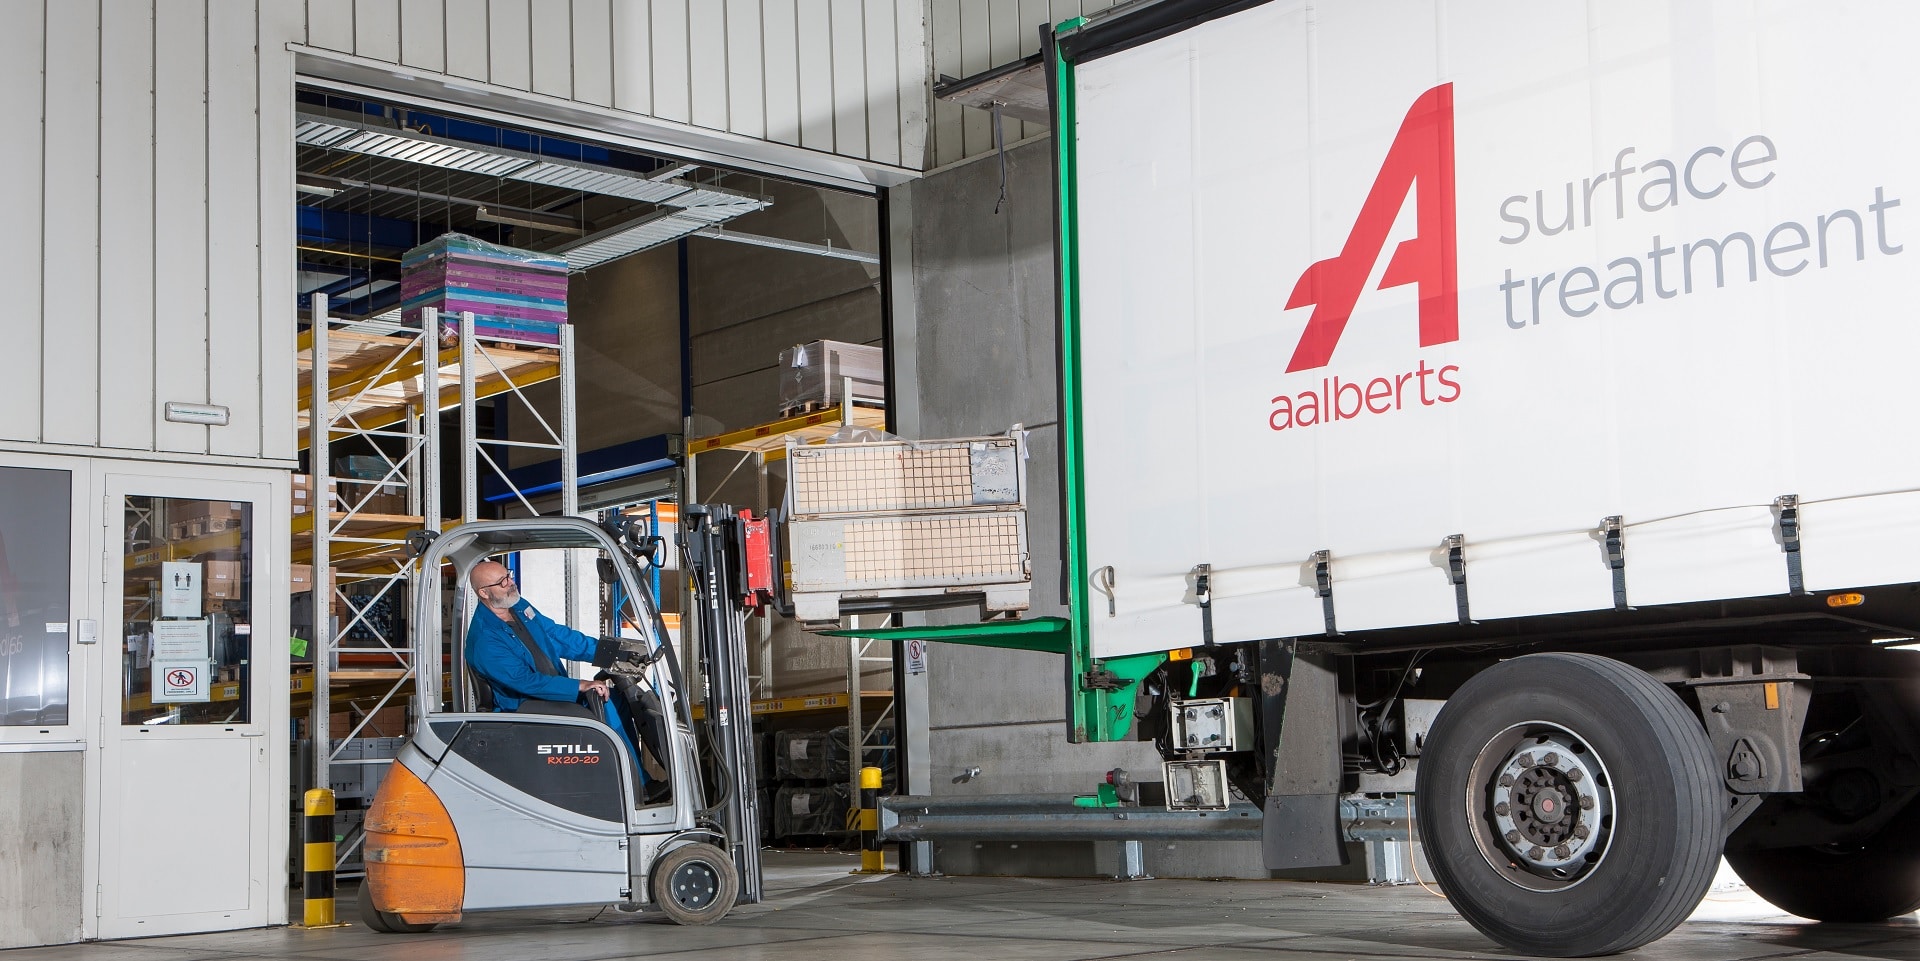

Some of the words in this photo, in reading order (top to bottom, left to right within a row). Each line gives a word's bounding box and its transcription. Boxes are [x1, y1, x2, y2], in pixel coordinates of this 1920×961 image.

[1499, 134, 1778, 245] surface
[1499, 186, 1904, 330] treatment
[1268, 359, 1461, 432] aalberts
[709, 566, 719, 610] STILL
[537, 744, 600, 754] STILL
